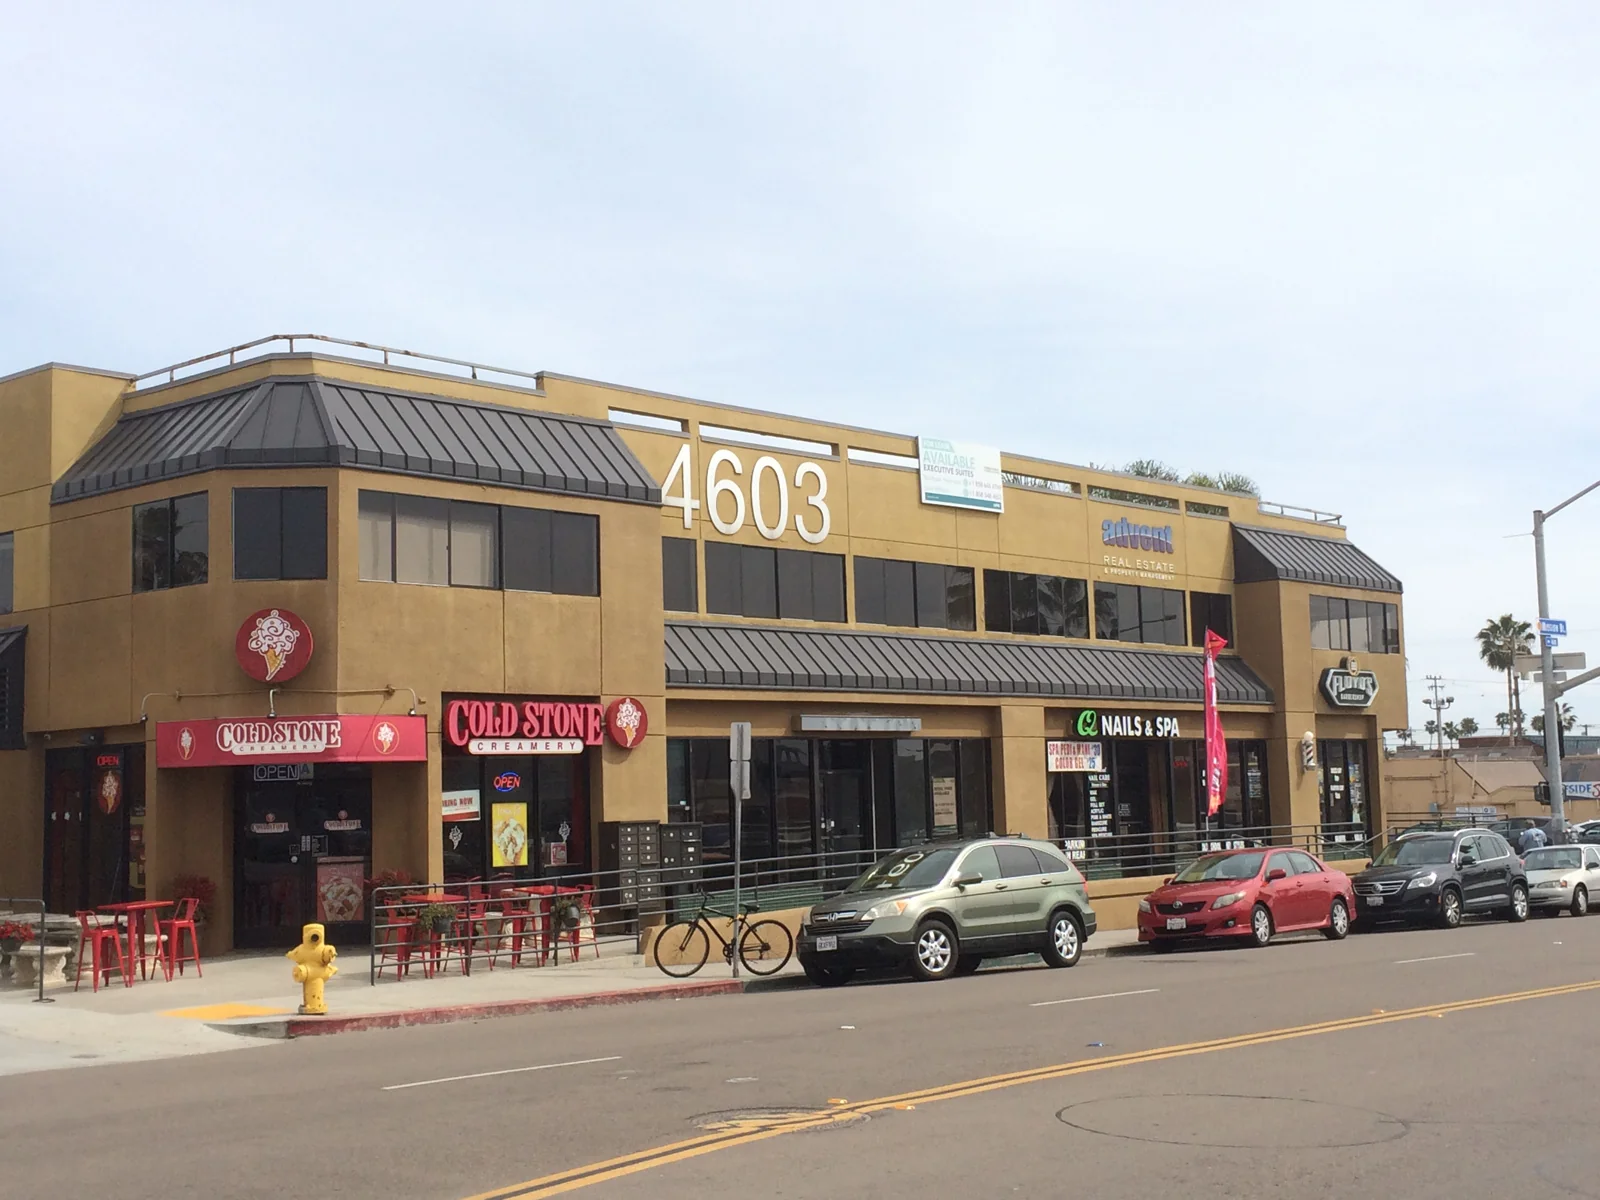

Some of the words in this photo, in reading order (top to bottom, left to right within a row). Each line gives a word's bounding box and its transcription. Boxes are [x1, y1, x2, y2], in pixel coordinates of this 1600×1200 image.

[923, 451, 975, 470] AVAILABLE
[923, 463, 954, 475] EXECUTIVE
[955, 467, 974, 478] SUITES
[661, 444, 830, 543] 4603
[1101, 516, 1174, 554] advent
[1103, 555, 1131, 567] REAL
[1136, 559, 1175, 573] ESTATE
[1110, 569, 1138, 577] PROPERTY
[1140, 571, 1175, 581] MANAGEMENT
[448, 700, 518, 747] COLD
[522, 701, 604, 746] STONE
[1077, 710, 1099, 737] Q
[1101, 715, 1142, 737] NAILS
[1144, 719, 1153, 737] &
[1156, 716, 1180, 738] SPA
[217, 723, 271, 751] COLD
[272, 721, 341, 748] STONE
[239, 744, 319, 752] CREAMERY
[477, 741, 576, 751] CREAMERY
[97, 755, 119, 766] OPEN
[1074, 756, 1085, 769] GEL
[256, 764, 298, 779] OPEN
[493, 776, 521, 788] OPEN
[459, 797, 473, 805] NOW
